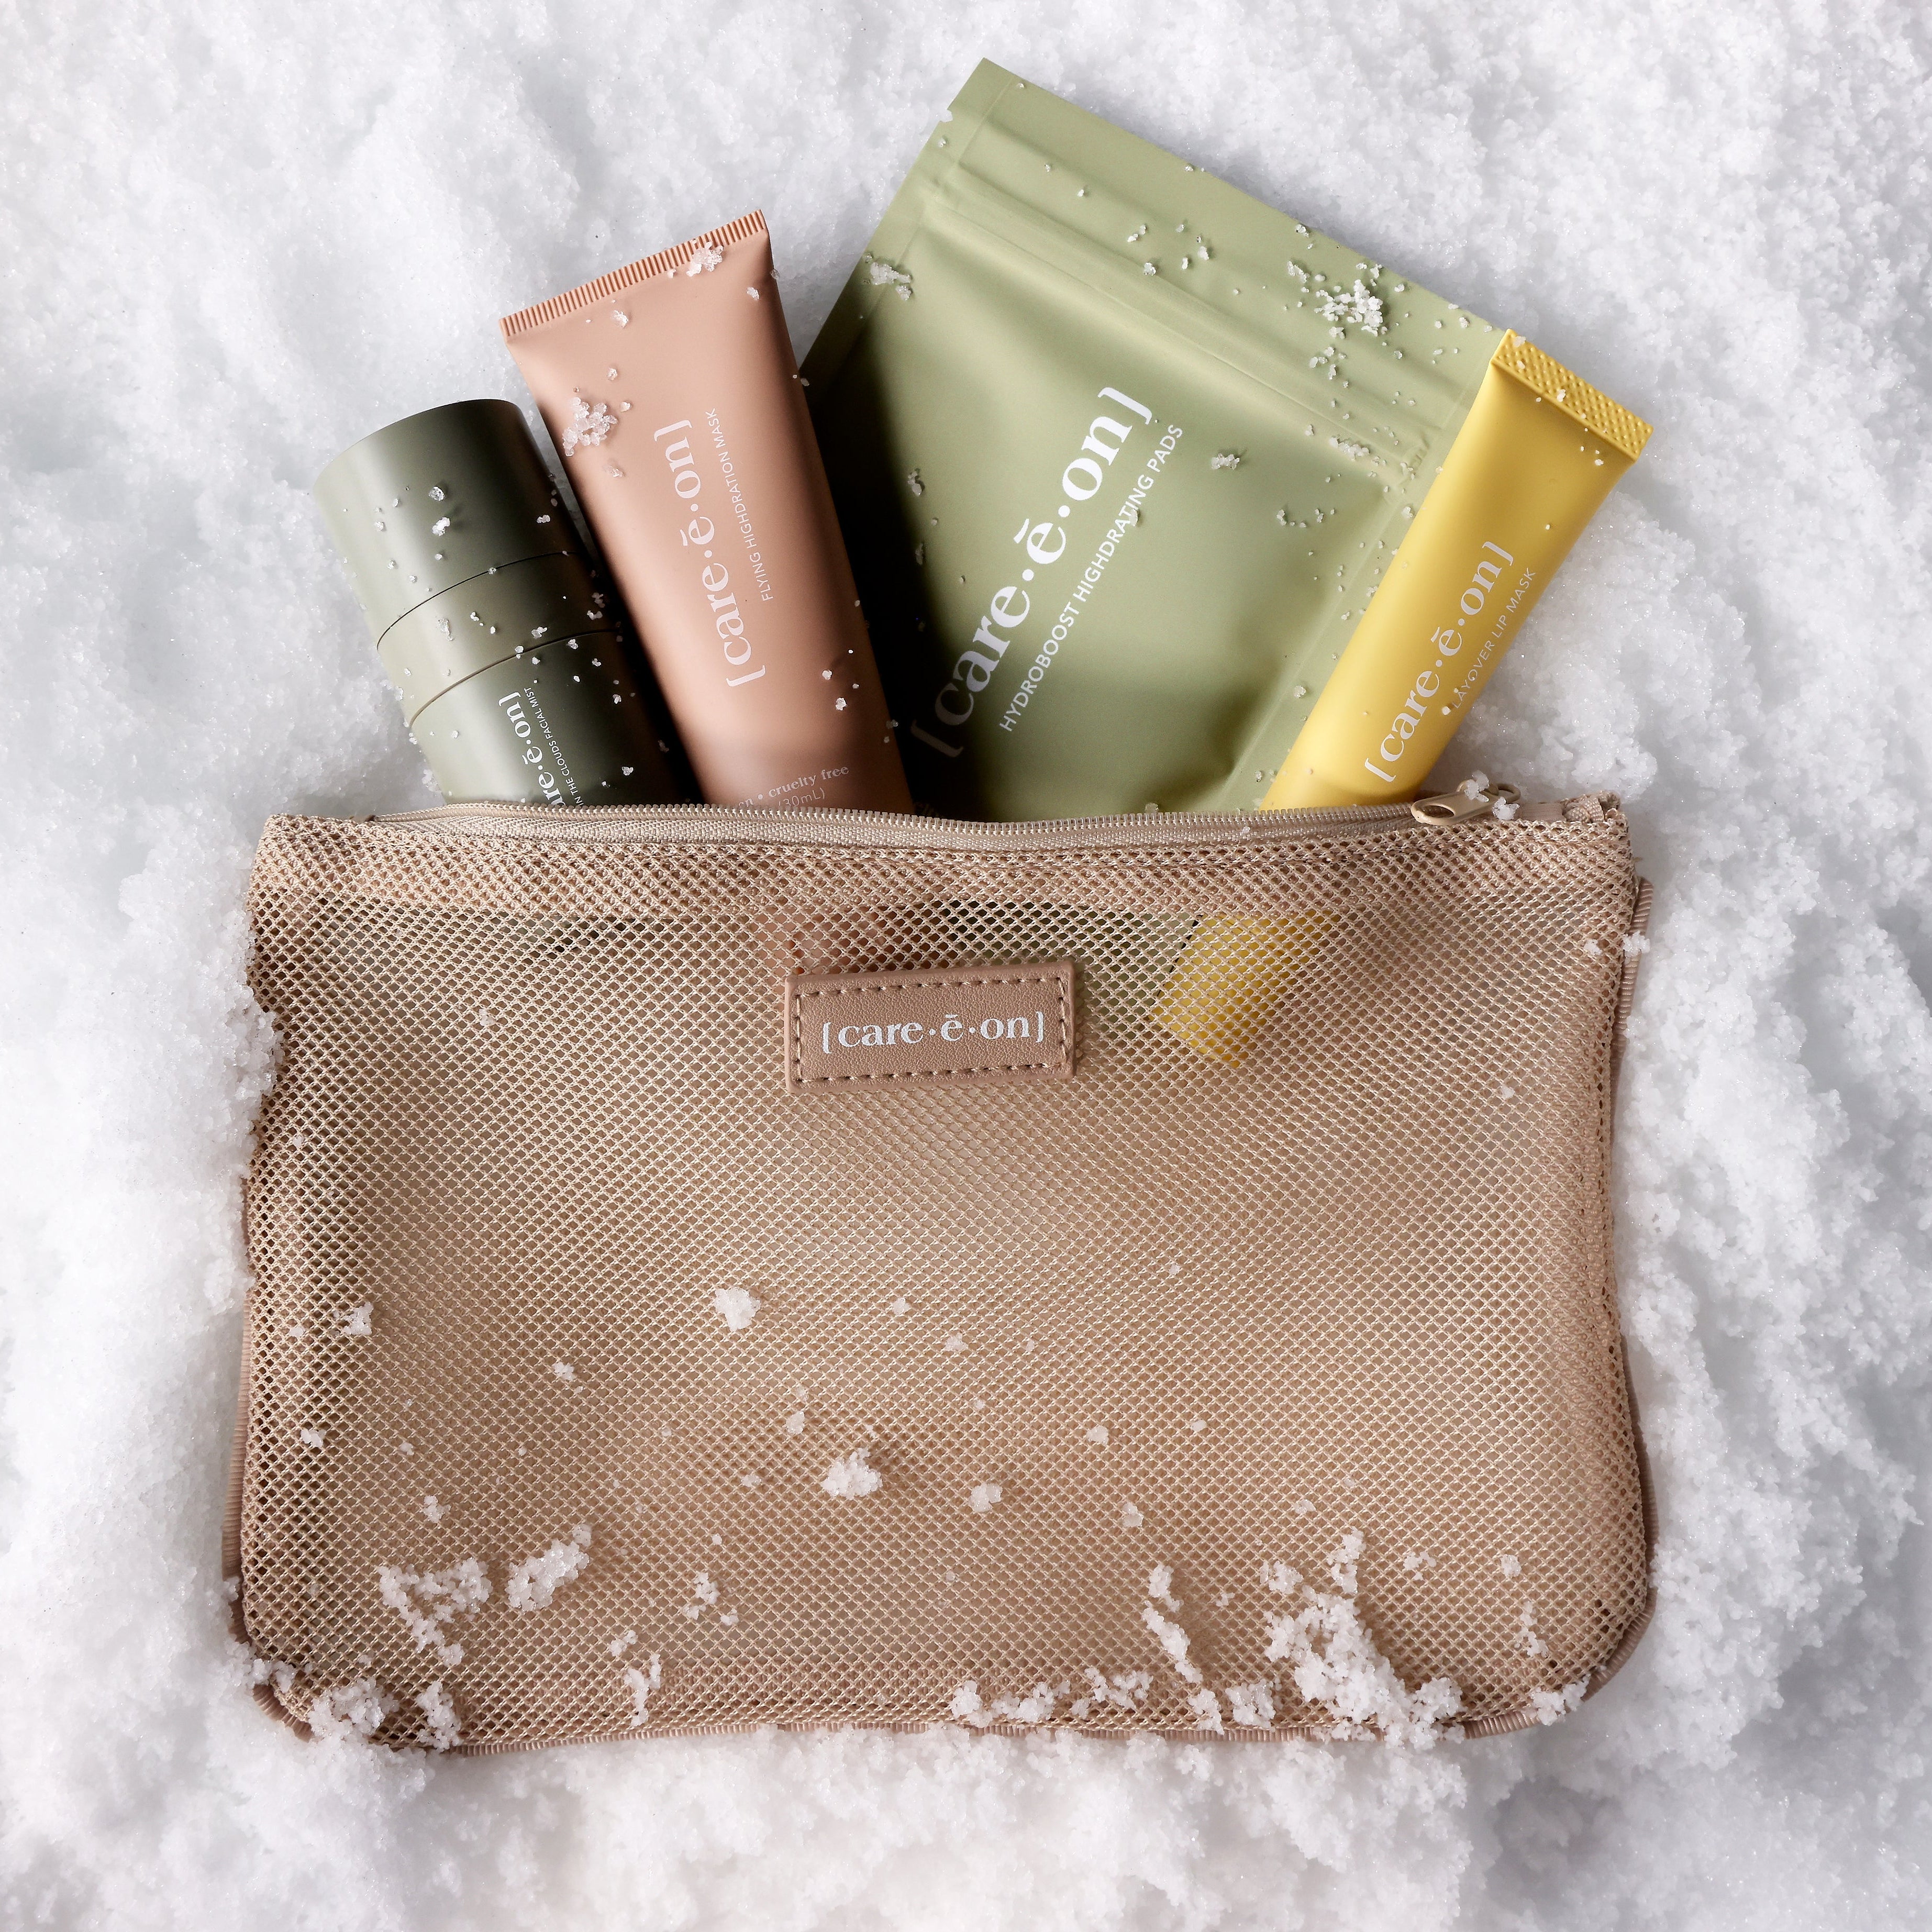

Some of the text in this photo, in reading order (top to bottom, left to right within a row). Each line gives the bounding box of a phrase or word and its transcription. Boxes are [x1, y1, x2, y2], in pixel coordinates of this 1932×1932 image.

[705, 408, 774, 601] FLYING HIGHDRATION MASK
[1000, 425, 1183, 731] HYDROBOOST HIGHDRATING PADS
[1452, 568, 1536, 708] LAYOVER LIP MASK
[524, 687, 584, 806] IN THE CLOUDS FACIAL MIST
[769, 767, 849, 798] cruelty free
